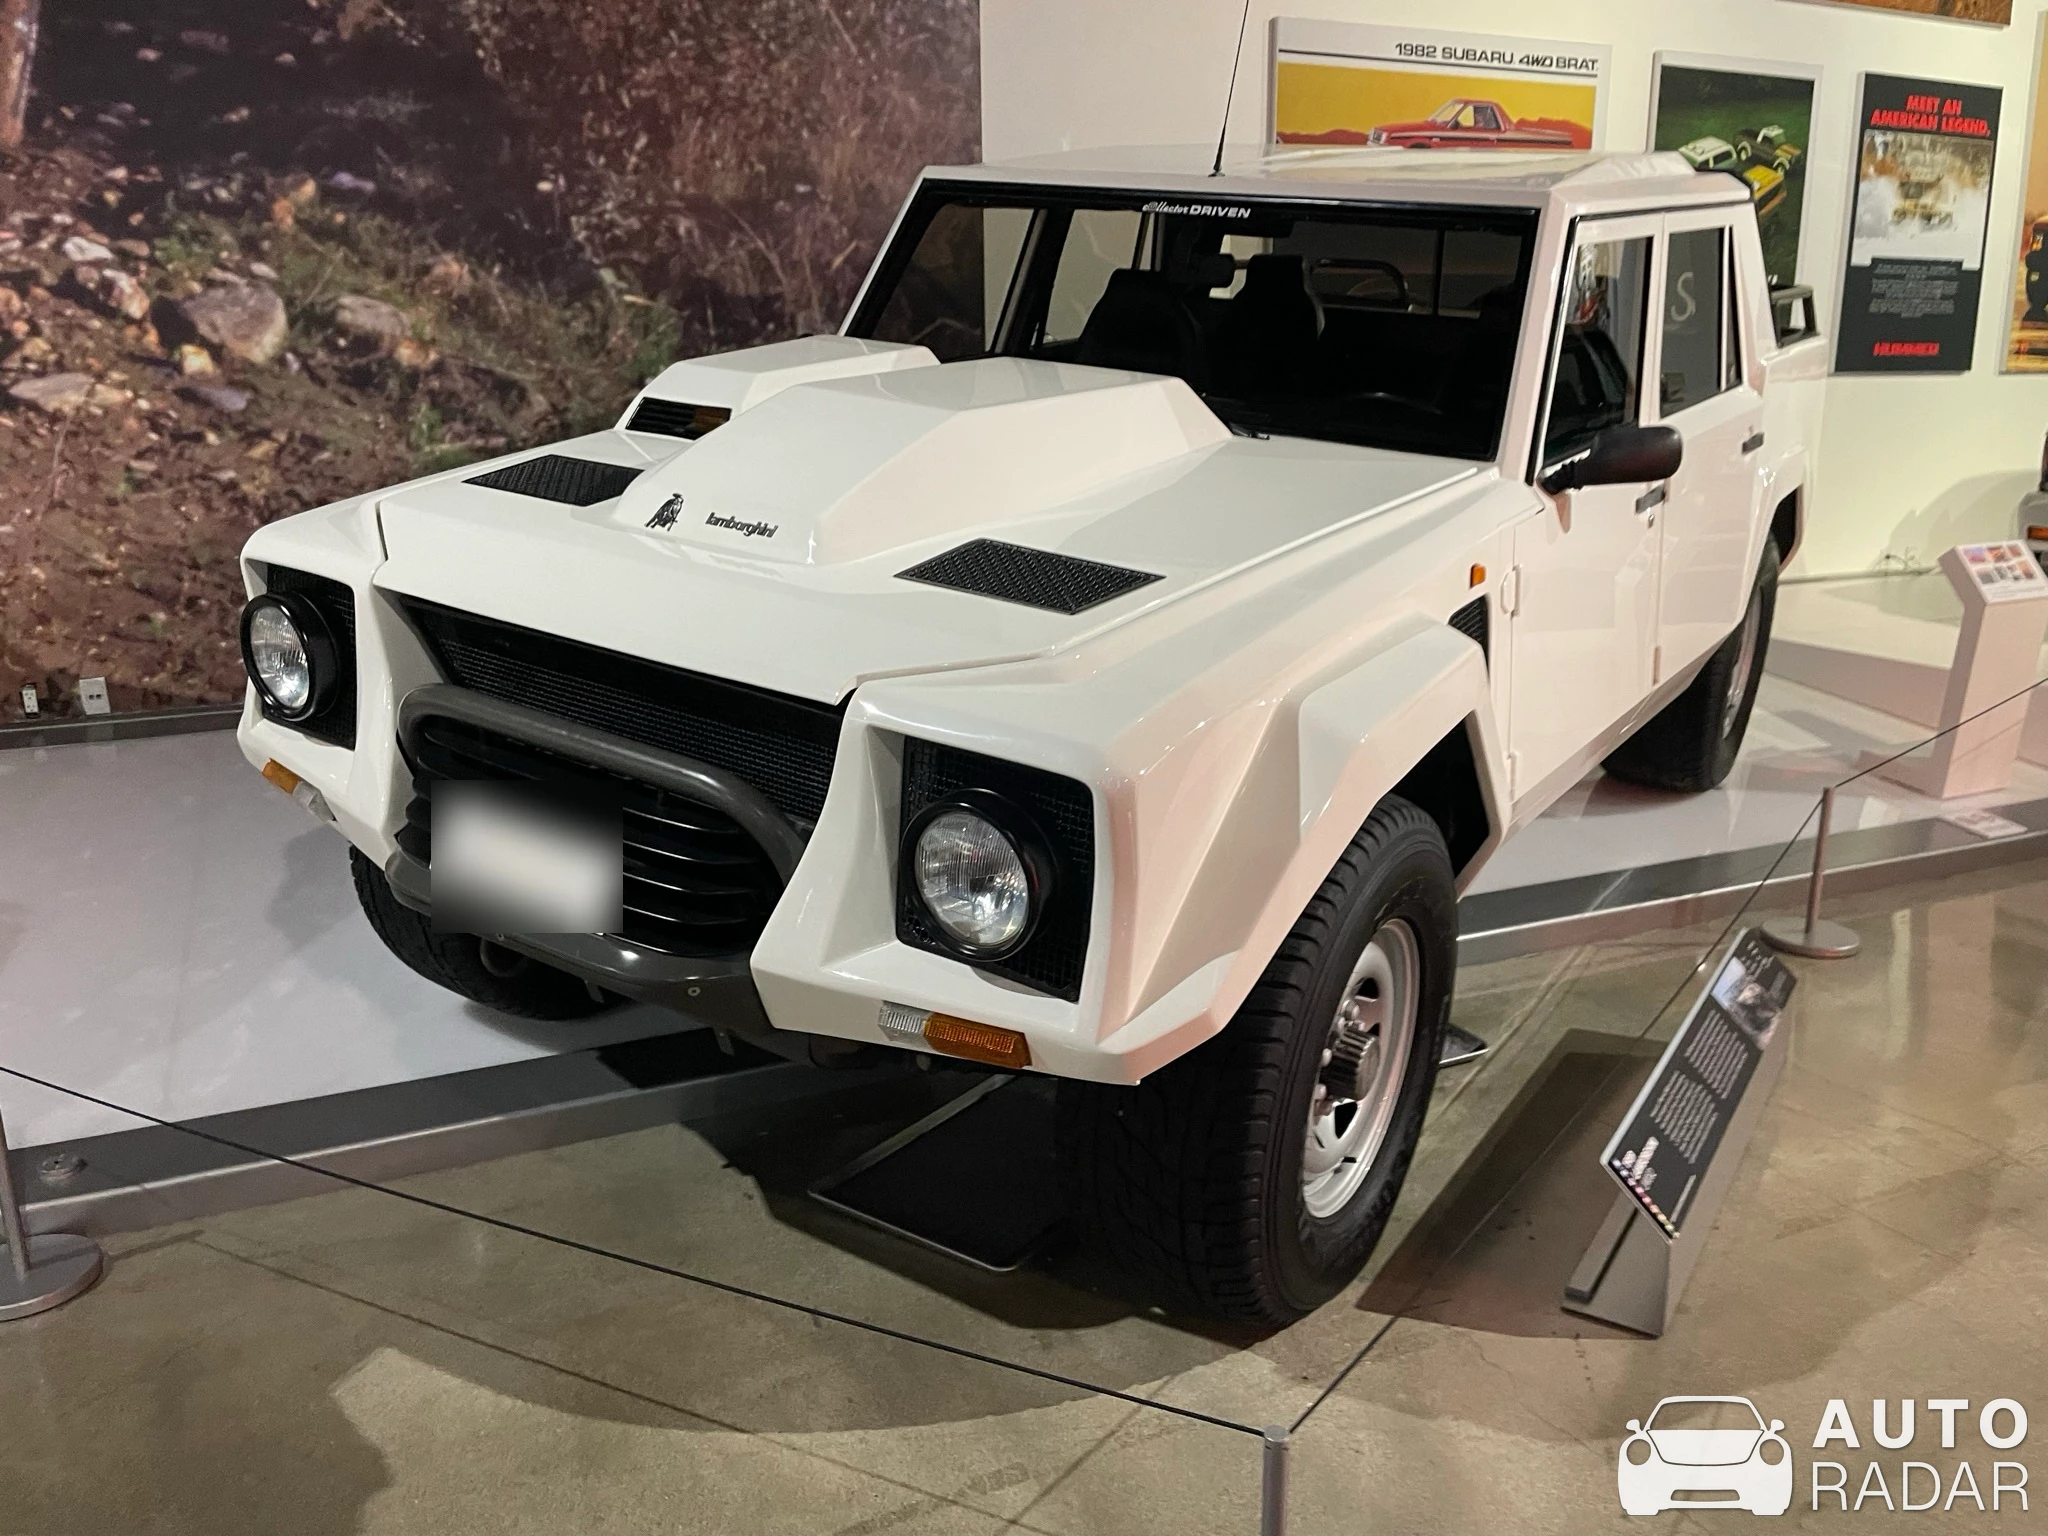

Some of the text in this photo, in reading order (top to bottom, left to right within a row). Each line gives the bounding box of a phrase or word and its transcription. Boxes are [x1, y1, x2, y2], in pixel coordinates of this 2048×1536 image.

[1395, 43, 1437, 58] 1982
[1441, 46, 1514, 65] SUBARU
[1518, 54, 1553, 68] 4WD
[1906, 95, 1962, 116] MEET AN
[1871, 109, 1938, 130] AMERICAN
[1189, 204, 1251, 219] DRIVEN
